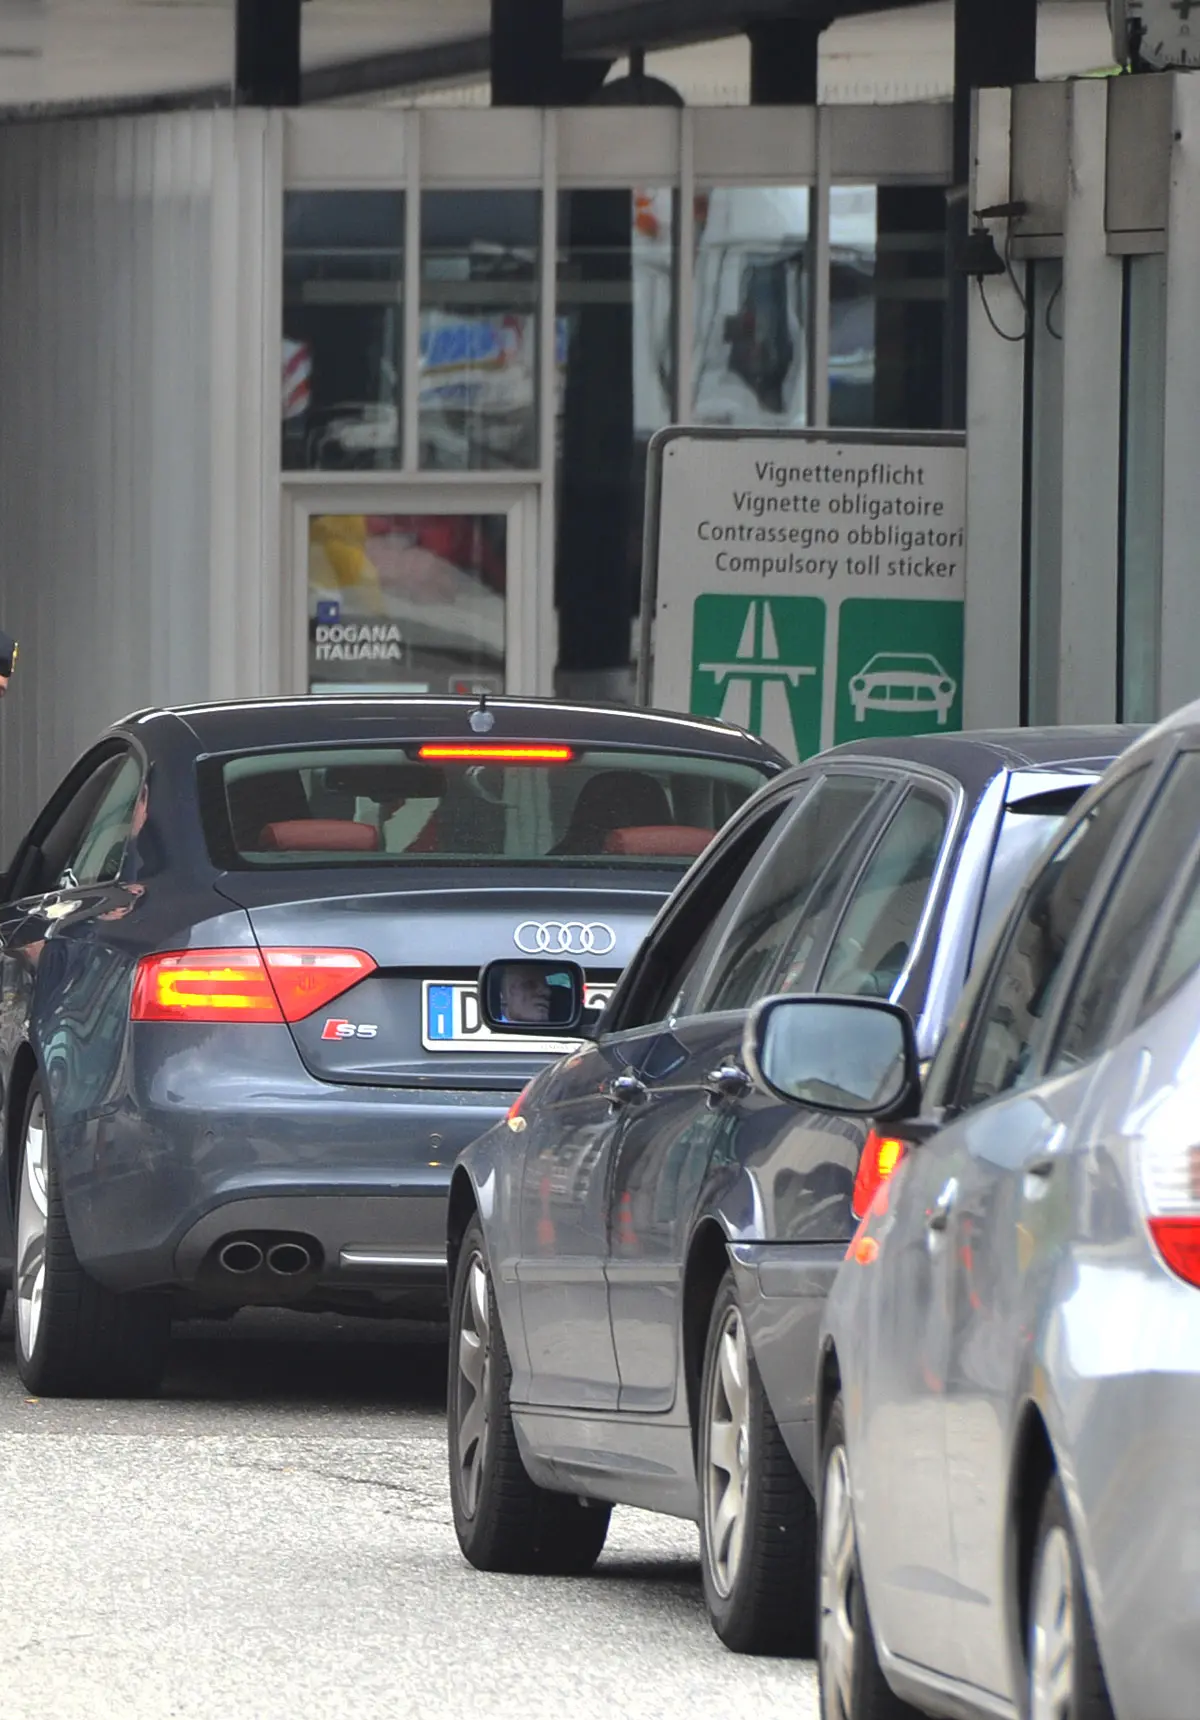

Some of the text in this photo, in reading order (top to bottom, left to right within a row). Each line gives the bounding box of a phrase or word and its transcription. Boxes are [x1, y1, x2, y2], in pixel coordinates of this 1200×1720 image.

[755, 461, 924, 488] Vignettenpflicht
[733, 491, 944, 520] Vignette obligatoire
[697, 521, 964, 551] Contrassegno obbligatori
[715, 552, 957, 579] Compulsory toll sticker
[315, 624, 401, 642] DOGANA
[315, 643, 401, 661] ITALIANA
[335, 1022, 378, 1038] S5
